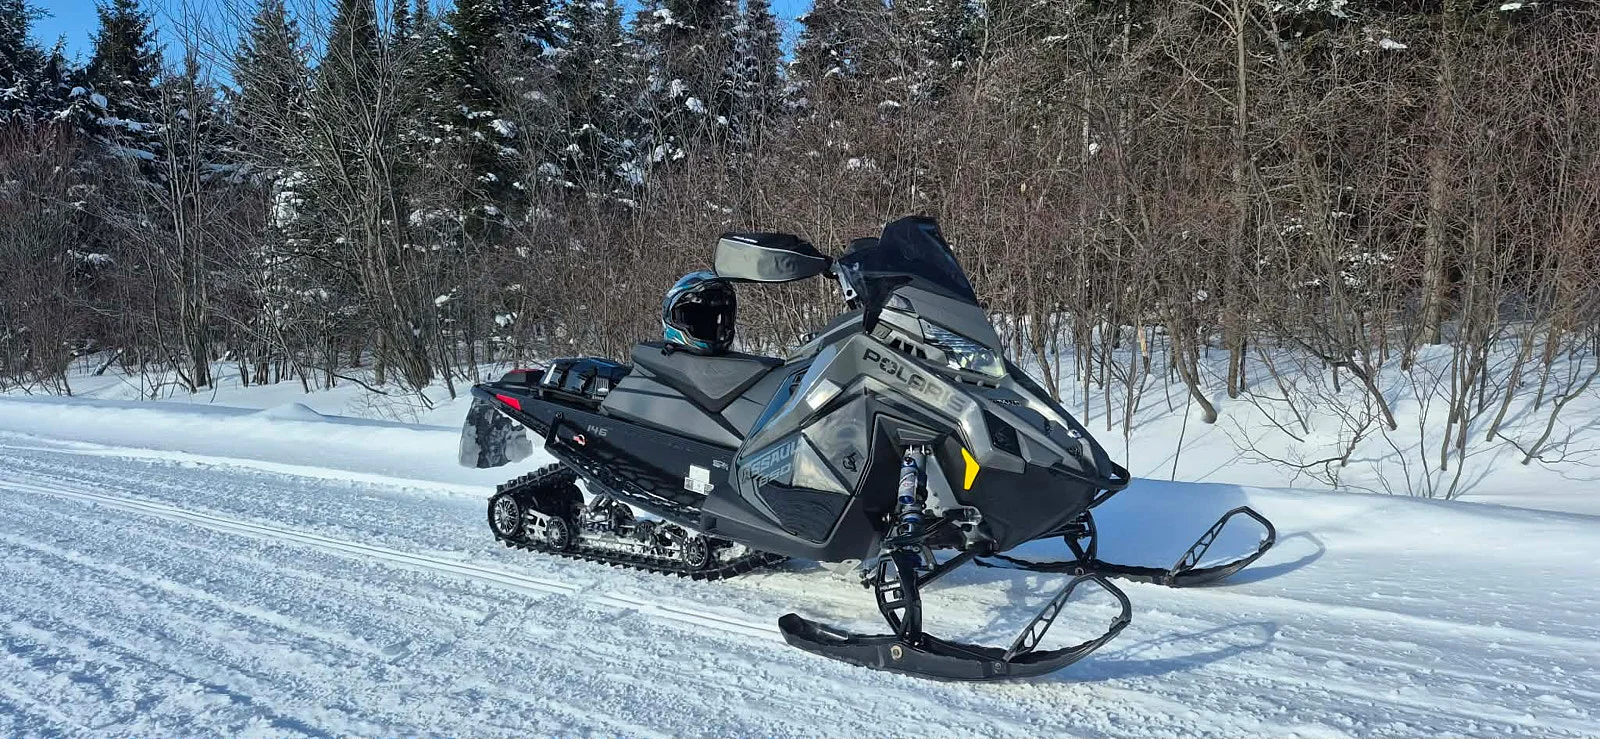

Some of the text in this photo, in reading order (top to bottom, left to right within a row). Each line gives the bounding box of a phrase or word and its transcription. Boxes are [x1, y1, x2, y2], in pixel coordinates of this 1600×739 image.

[863, 348, 966, 412] POLARIS
[586, 424, 609, 437] 146
[742, 441, 800, 482] ASSAUL
[759, 462, 792, 488] 850
